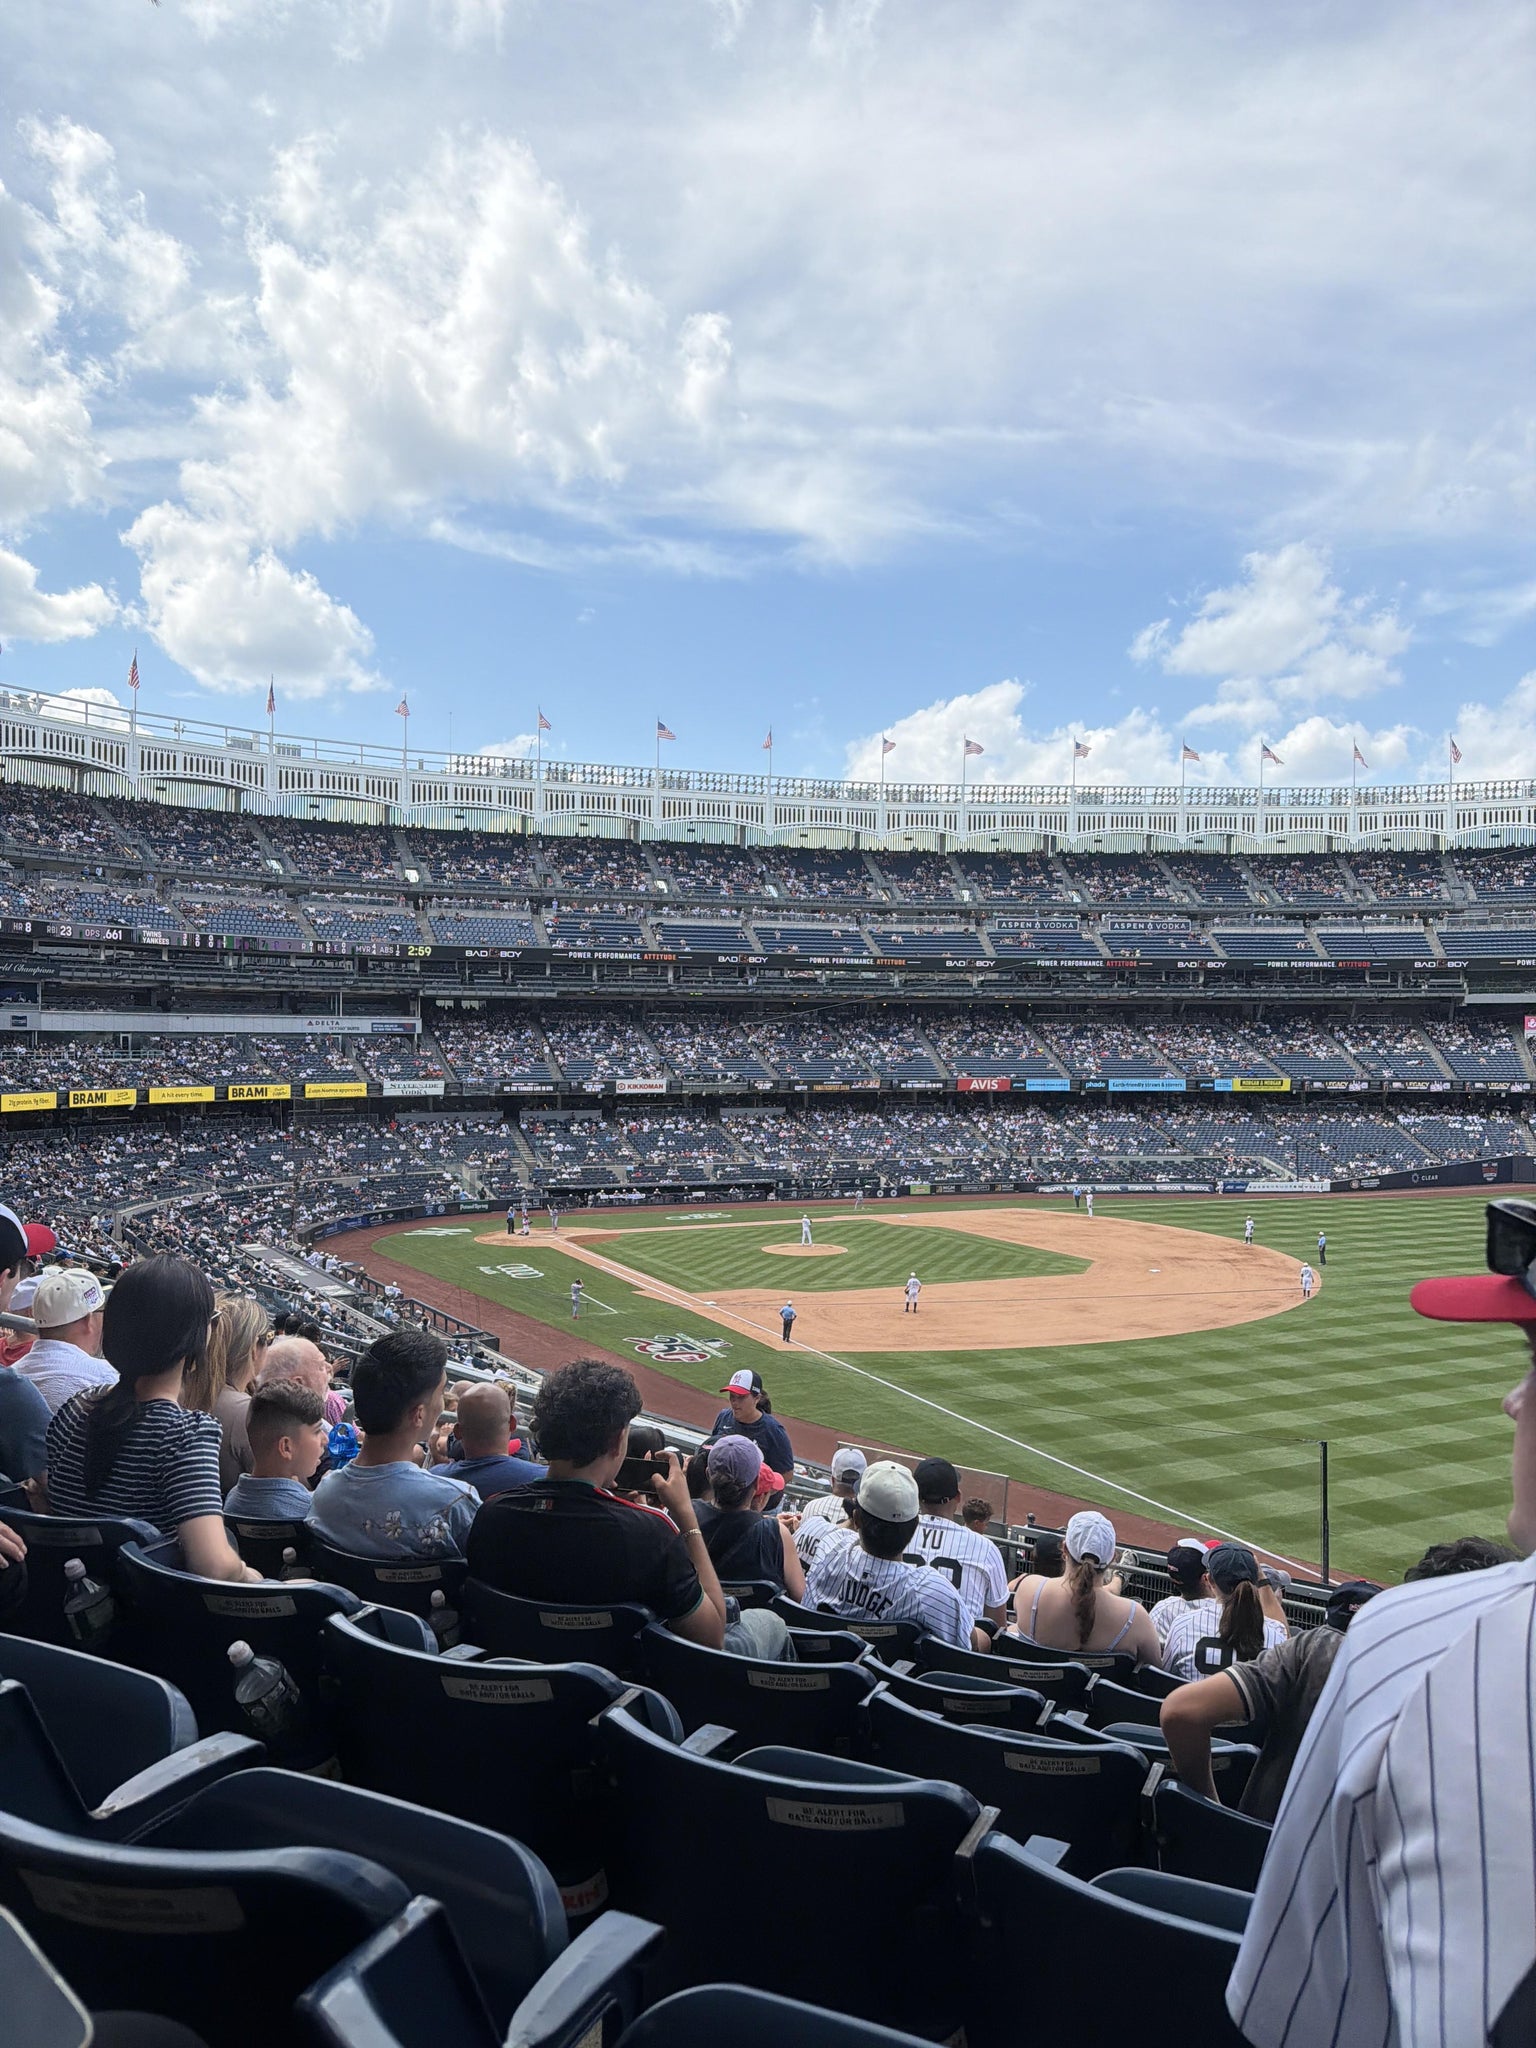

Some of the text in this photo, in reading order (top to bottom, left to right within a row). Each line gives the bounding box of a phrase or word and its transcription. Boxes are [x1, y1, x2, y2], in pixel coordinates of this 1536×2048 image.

[14, 922, 32, 933] HR 8
[1001, 921, 1074, 929] ASPEN VODKA
[1114, 922, 1186, 930] ASPEN VODKA
[47, 926, 73, 937] RBI 23
[85, 929, 122, 940] OPS .661
[142, 937, 170, 945] YANKEES
[356, 945, 371, 953] MVR
[379, 946, 394, 954] ABS
[407, 945, 432, 957] 2:59
[465, 950, 522, 958] BAD BOY
[643, 953, 677, 961] ATTITUDE
[14, 963, 55, 976] Champions
[970, 1079, 998, 1089] AVIS
[72, 1092, 107, 1105] BRAMI
[231, 1087, 268, 1099] BRAMI
[922, 1528, 943, 1549] YU
[838, 1578, 893, 1619] JUDGE
